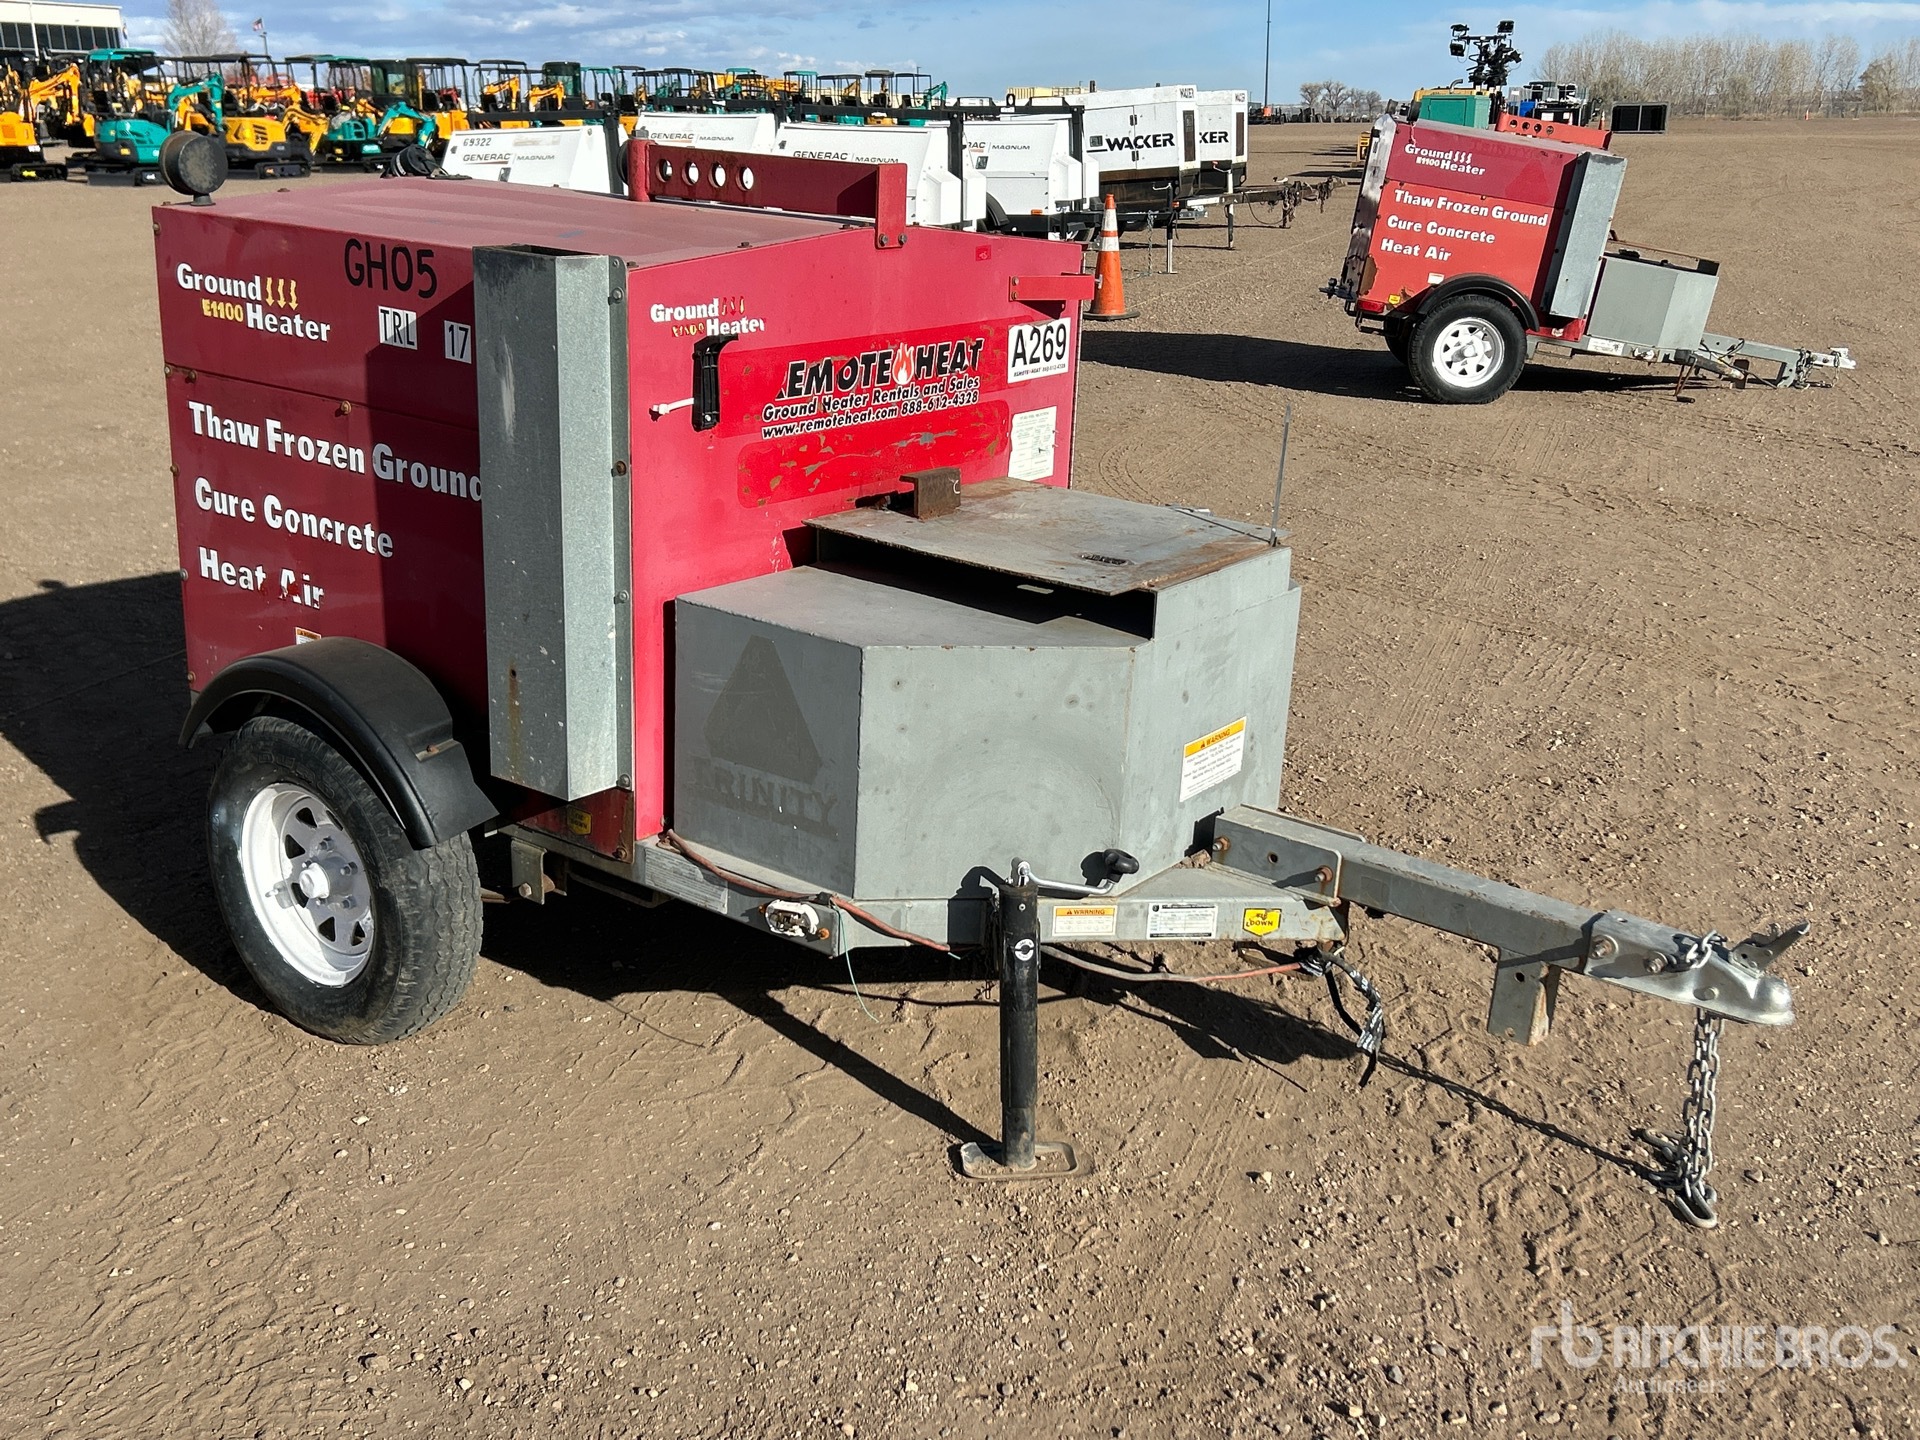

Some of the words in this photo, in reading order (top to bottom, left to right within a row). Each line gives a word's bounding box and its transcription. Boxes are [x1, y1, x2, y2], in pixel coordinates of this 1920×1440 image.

[463, 137, 492, 147] 69322
[650, 132, 695, 141] GENERAC
[1106, 132, 1176, 152] WACKER
[1199, 131, 1229, 144] KER
[463, 152, 511, 162] GENERAC
[793, 149, 849, 161] GENERAC
[1404, 143, 1453, 161] Ground
[1440, 159, 1486, 176] Heater
[1394, 189, 1435, 208] Thaw
[1437, 196, 1489, 217] Frozen
[1491, 205, 1549, 226] Ground
[1387, 215, 1423, 233] Cure
[1426, 221, 1496, 244] Concrete
[1380, 238, 1421, 257] Heat
[1425, 245, 1452, 262] Air
[176, 262, 262, 303] Ground
[201, 298, 244, 324] E1100
[246, 302, 331, 343] Heater
[650, 297, 720, 323] Ground
[380, 307, 417, 349] TRL
[1012, 323, 1067, 368] A269
[775, 347, 894, 402] EMOTE
[914, 338, 985, 381] HEAT
[763, 397, 817, 423] Ground
[821, 392, 870, 414] Heater
[872, 384, 920, 405] Rentals
[923, 378, 946, 396] and
[948, 375, 980, 393] Sales
[761, 406, 898, 440] www.remoteheat.com
[900, 390, 980, 416] 888-612-4328
[188, 401, 259, 450] Thaw
[266, 418, 365, 475] Frozen
[194, 477, 256, 523] Cure
[263, 495, 394, 559] Concrete
[199, 546, 268, 593] Heat
[278, 567, 325, 610] Air
[1206, 728, 1231, 746] WARNING
